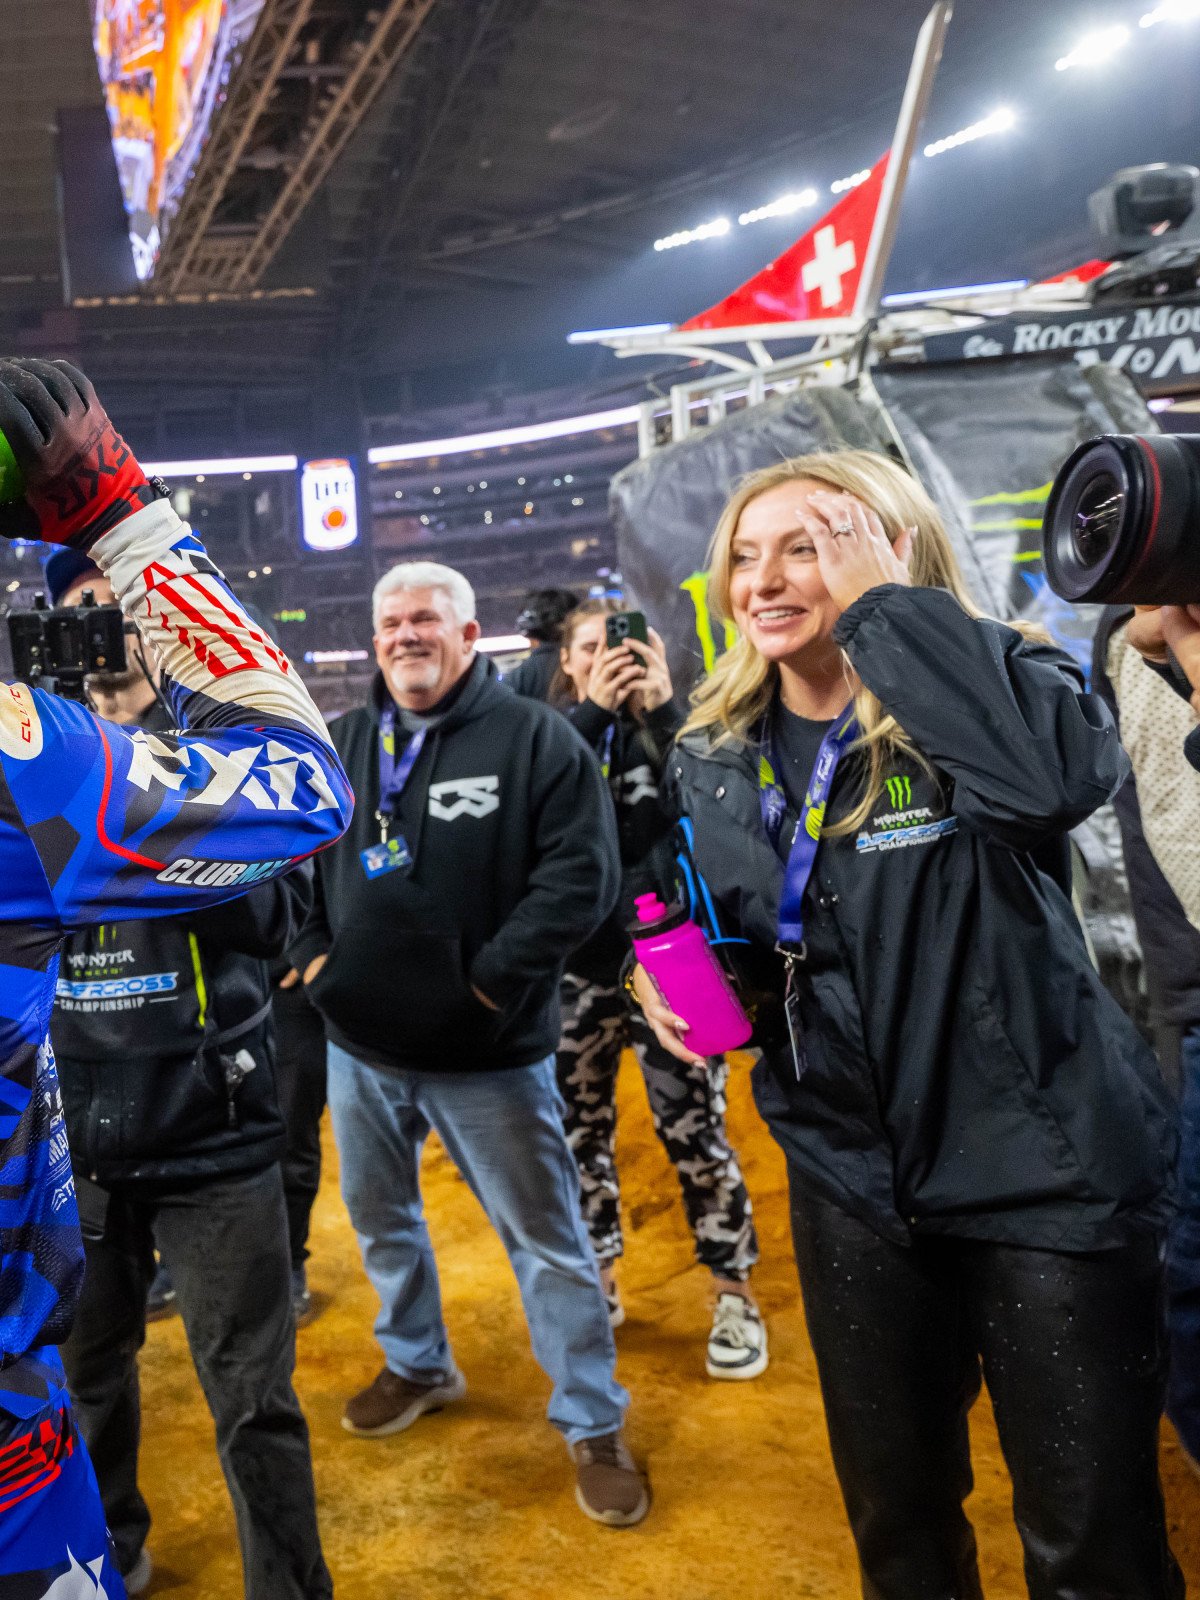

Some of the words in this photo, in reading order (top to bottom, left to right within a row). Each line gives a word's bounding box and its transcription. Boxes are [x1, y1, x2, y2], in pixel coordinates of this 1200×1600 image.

[1012, 316, 1127, 354] ROCKY
[151, 477, 171, 496] FXR
[873, 807, 933, 826] MONSTER
[156, 857, 294, 888] CLUBMX
[67, 949, 135, 968] MONSTER
[59, 996, 145, 1013] CHAMPIONSHIP
